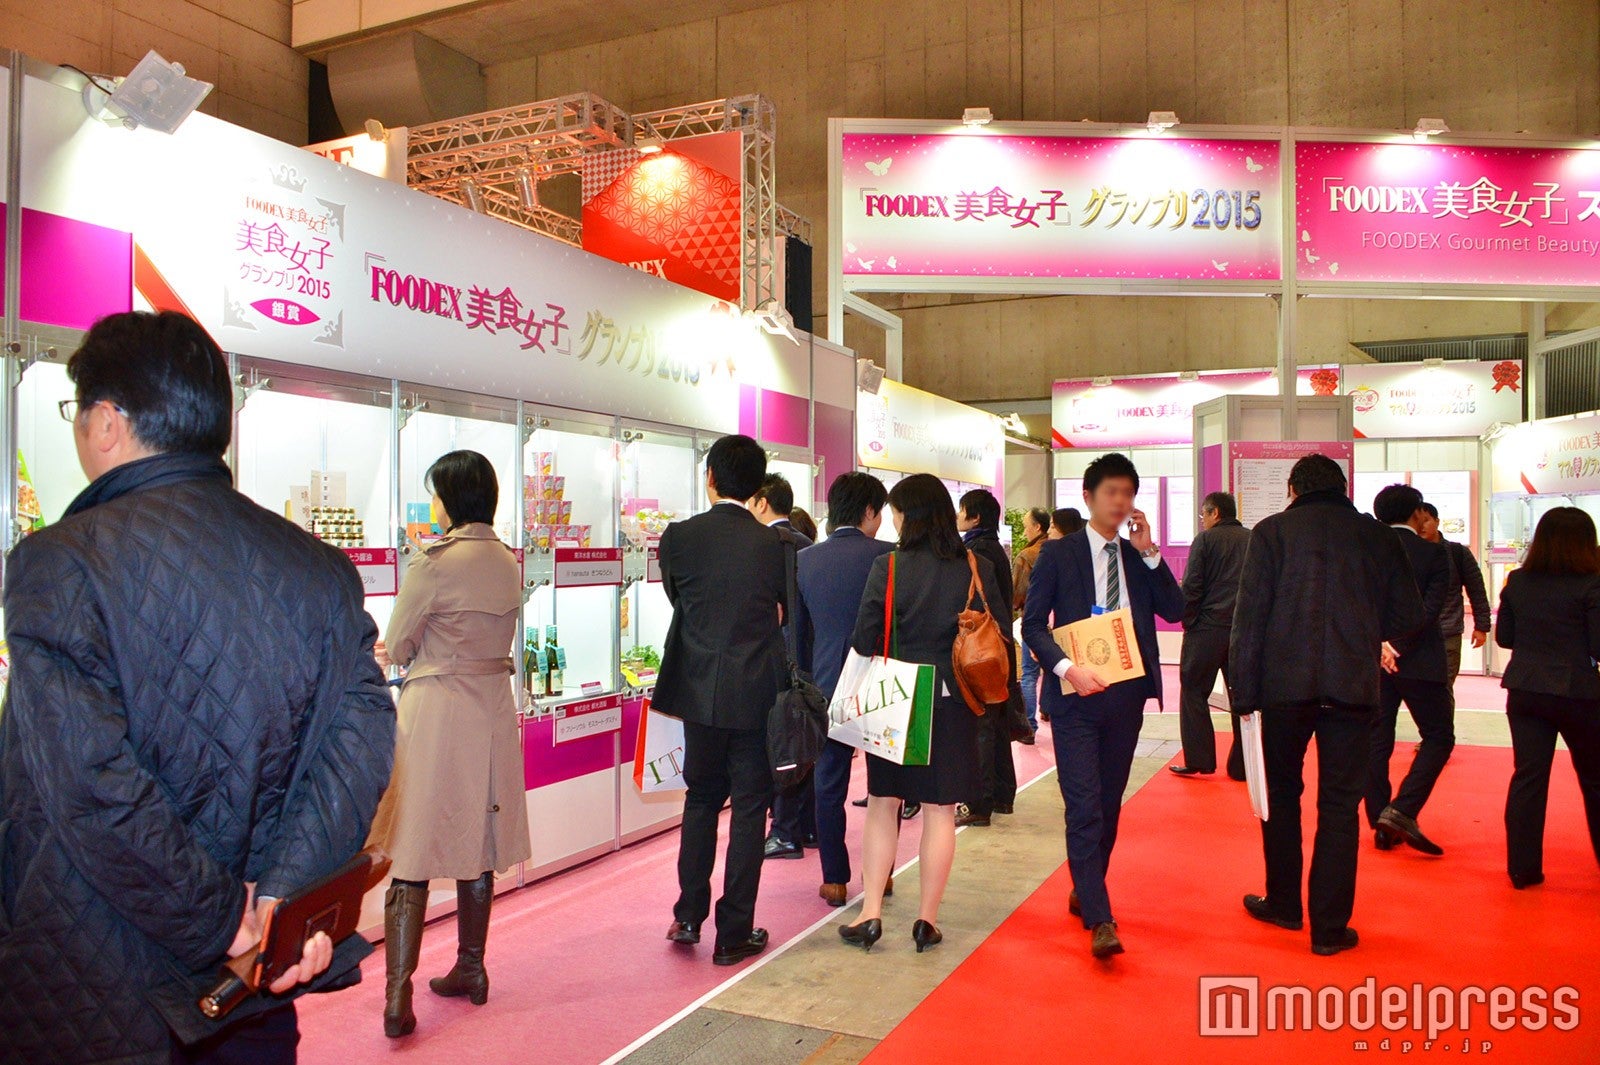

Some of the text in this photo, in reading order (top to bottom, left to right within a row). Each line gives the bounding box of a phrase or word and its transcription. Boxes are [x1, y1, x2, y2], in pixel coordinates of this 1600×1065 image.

[236, 219, 334, 275] 美食女子
[1361, 231, 1600, 257] FOODEX Gourmet Beauty
[271, 300, 300, 322] 銀賞
